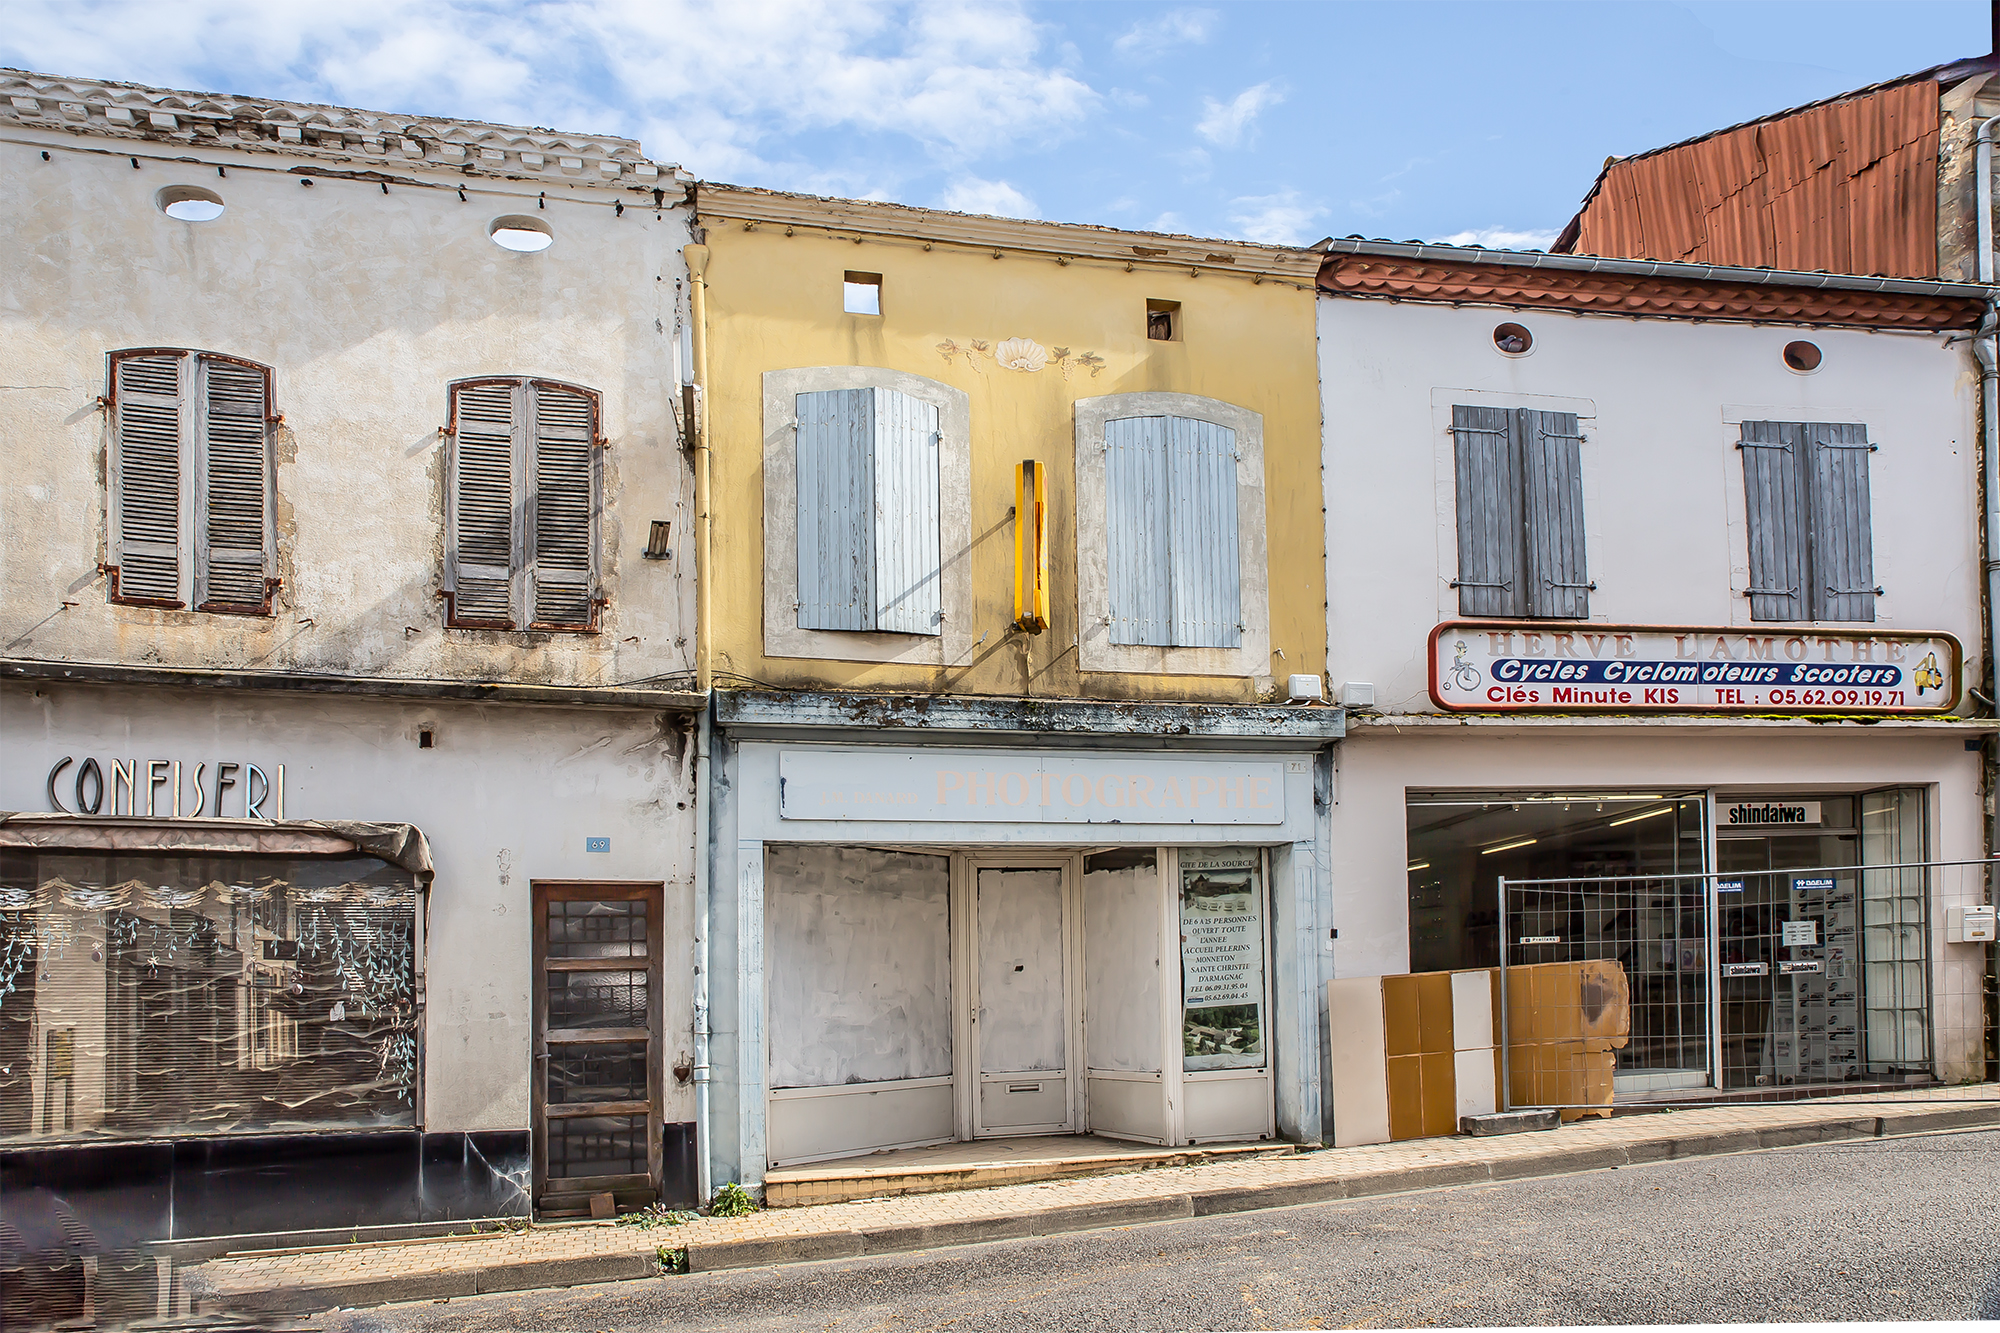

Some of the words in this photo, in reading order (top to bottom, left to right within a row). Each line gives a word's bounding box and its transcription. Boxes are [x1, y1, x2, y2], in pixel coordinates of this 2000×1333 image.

[1486, 632, 1635, 658] HERVE
[1674, 634, 1907, 663] LAMOTHE
[1498, 659, 1589, 683] Cycles
[1604, 660, 1778, 684] Cyclomoteurs
[1789, 663, 1897, 685] Scooters
[1486, 685, 1540, 704] Clés
[1552, 687, 1633, 704] Minute
[1645, 688, 1680, 704] KIS
[1716, 688, 1746, 704] TEL
[1769, 689, 1906, 707] 05.62.09.19.71
[1291, 763, 1301, 771] 71
[819, 791, 848, 806] J.M.
[854, 792, 918, 804] DANARD
[935, 769, 1275, 810] PHOTOGRAPHE
[1729, 803, 1805, 824] shindaiwa
[592, 841, 606, 849] 69
[1183, 918, 1194, 926] DE
[1213, 915, 1257, 924] PERSONNES
[1191, 927, 1219, 935] OUVERT
[1221, 925, 1247, 933] TOUTE
[1184, 946, 1214, 954] ACCUEIL
[1215, 944, 1251, 952] PELERINS
[1195, 954, 1236, 963] MONNETON
[1190, 965, 1216, 973] SAINTE
[1216, 963, 1250, 972] CHRISTIE
[1198, 973, 1244, 982] D'ARMAGNAC
[1190, 985, 1203, 993] TEL
